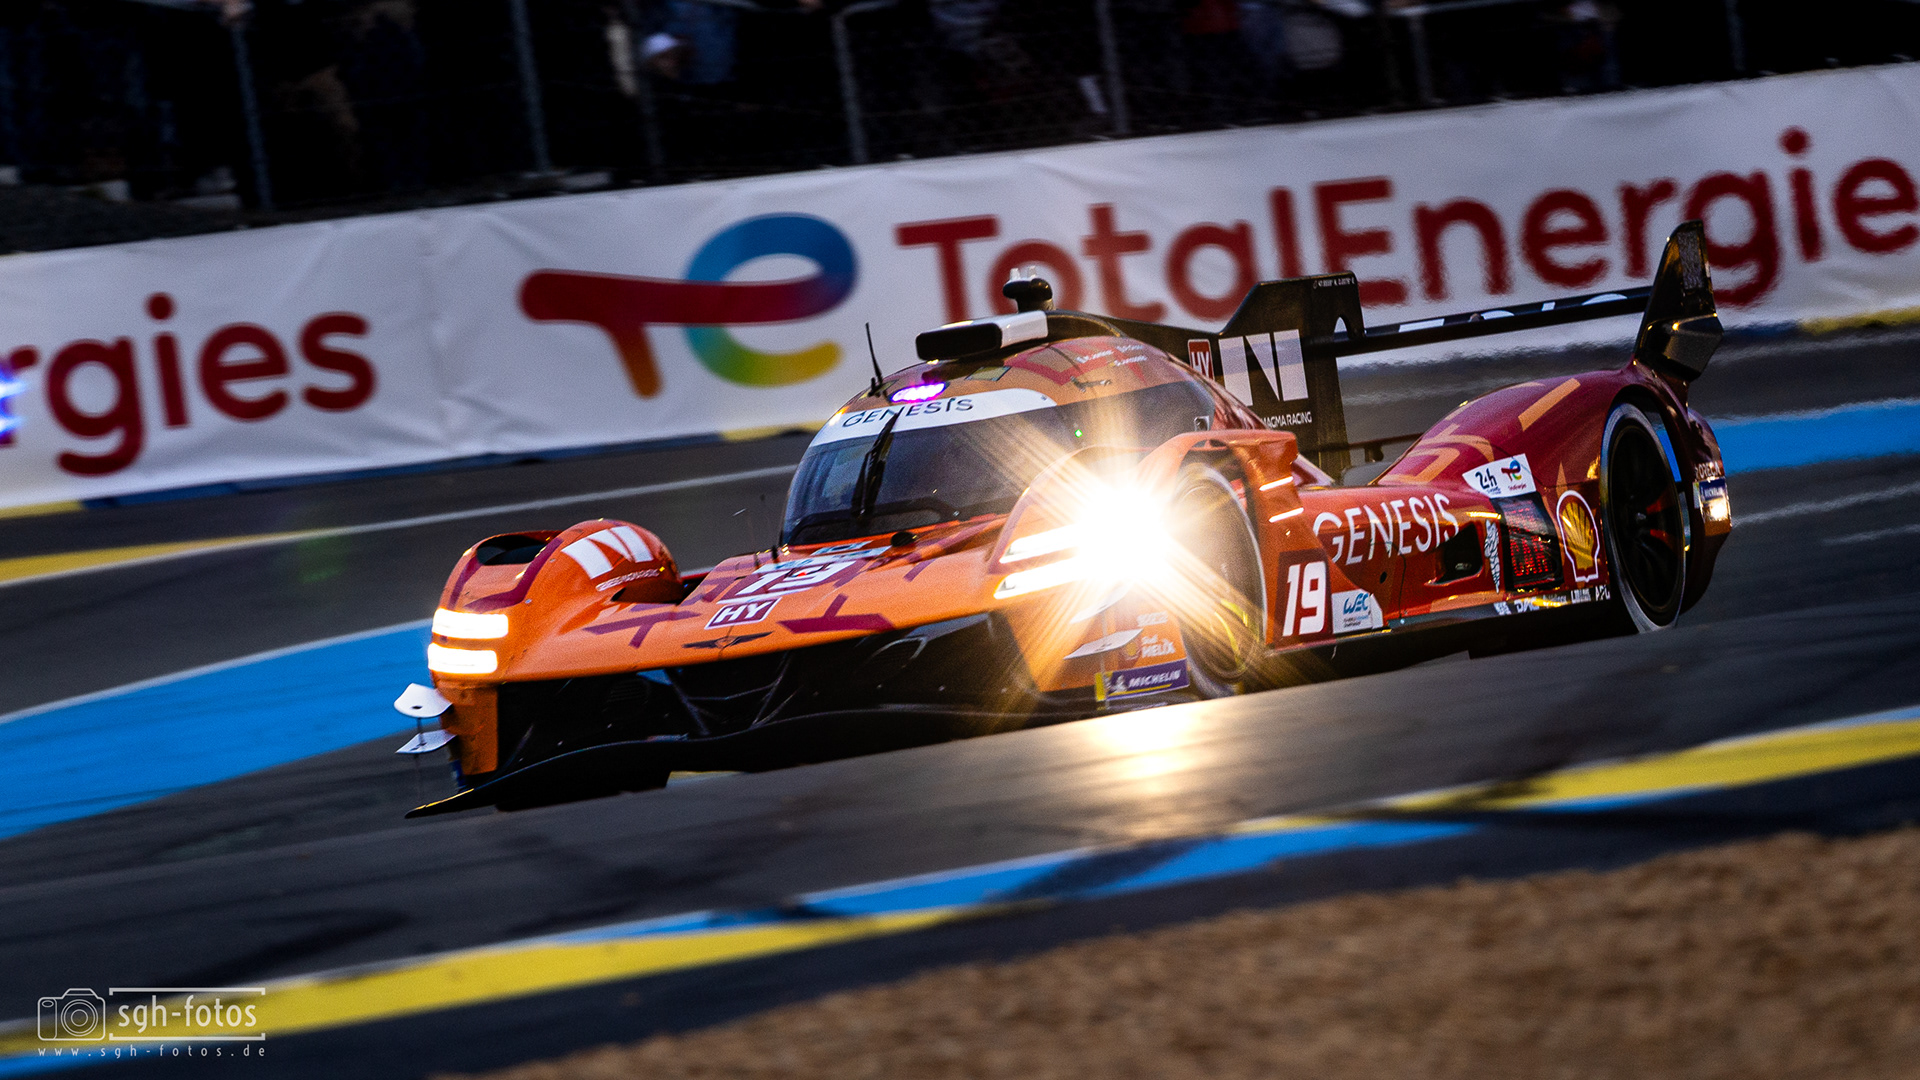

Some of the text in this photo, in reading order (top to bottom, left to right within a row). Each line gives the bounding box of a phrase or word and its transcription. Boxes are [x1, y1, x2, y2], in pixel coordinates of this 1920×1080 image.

[842, 398, 974, 428] GENESIS
[1287, 411, 1313, 425] RACING
[1312, 493, 1460, 566] GENESIS
[735, 560, 857, 596] 19
[1282, 560, 1327, 637] 19
[1343, 592, 1369, 615] WEC
[713, 601, 775, 623] HY
[1128, 669, 1182, 688] MICHELIN
